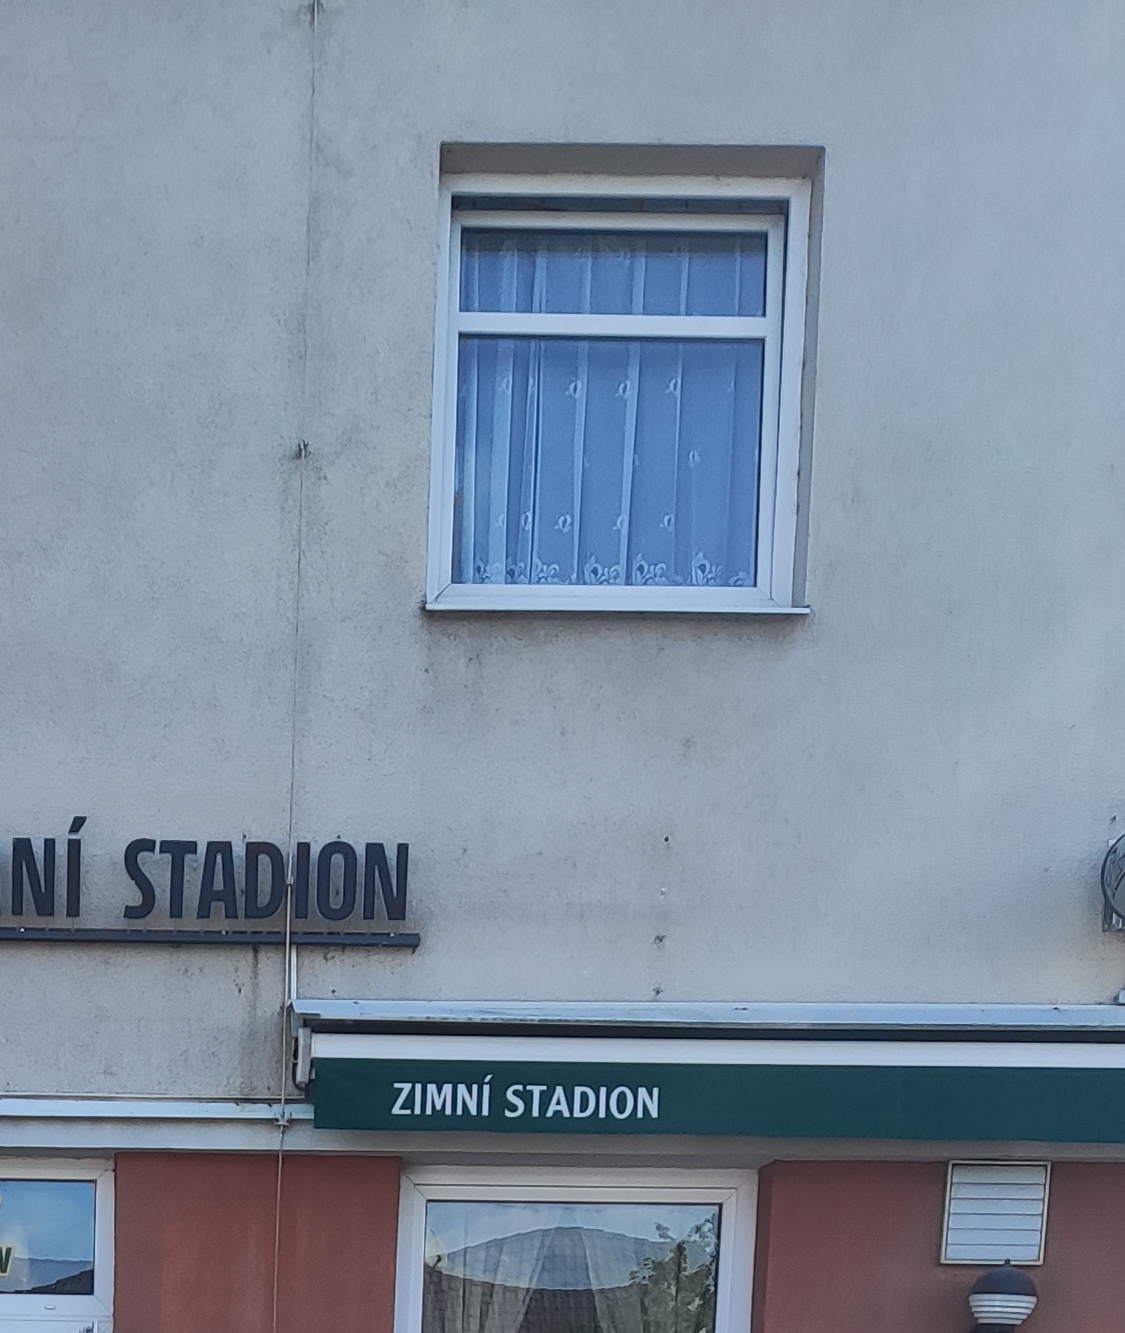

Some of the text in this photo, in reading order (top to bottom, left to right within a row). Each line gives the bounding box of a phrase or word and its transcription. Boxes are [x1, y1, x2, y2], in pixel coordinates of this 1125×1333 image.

[123, 838, 409, 921] STADION
[391, 1074, 659, 1119] ZIMNÍ STADION
